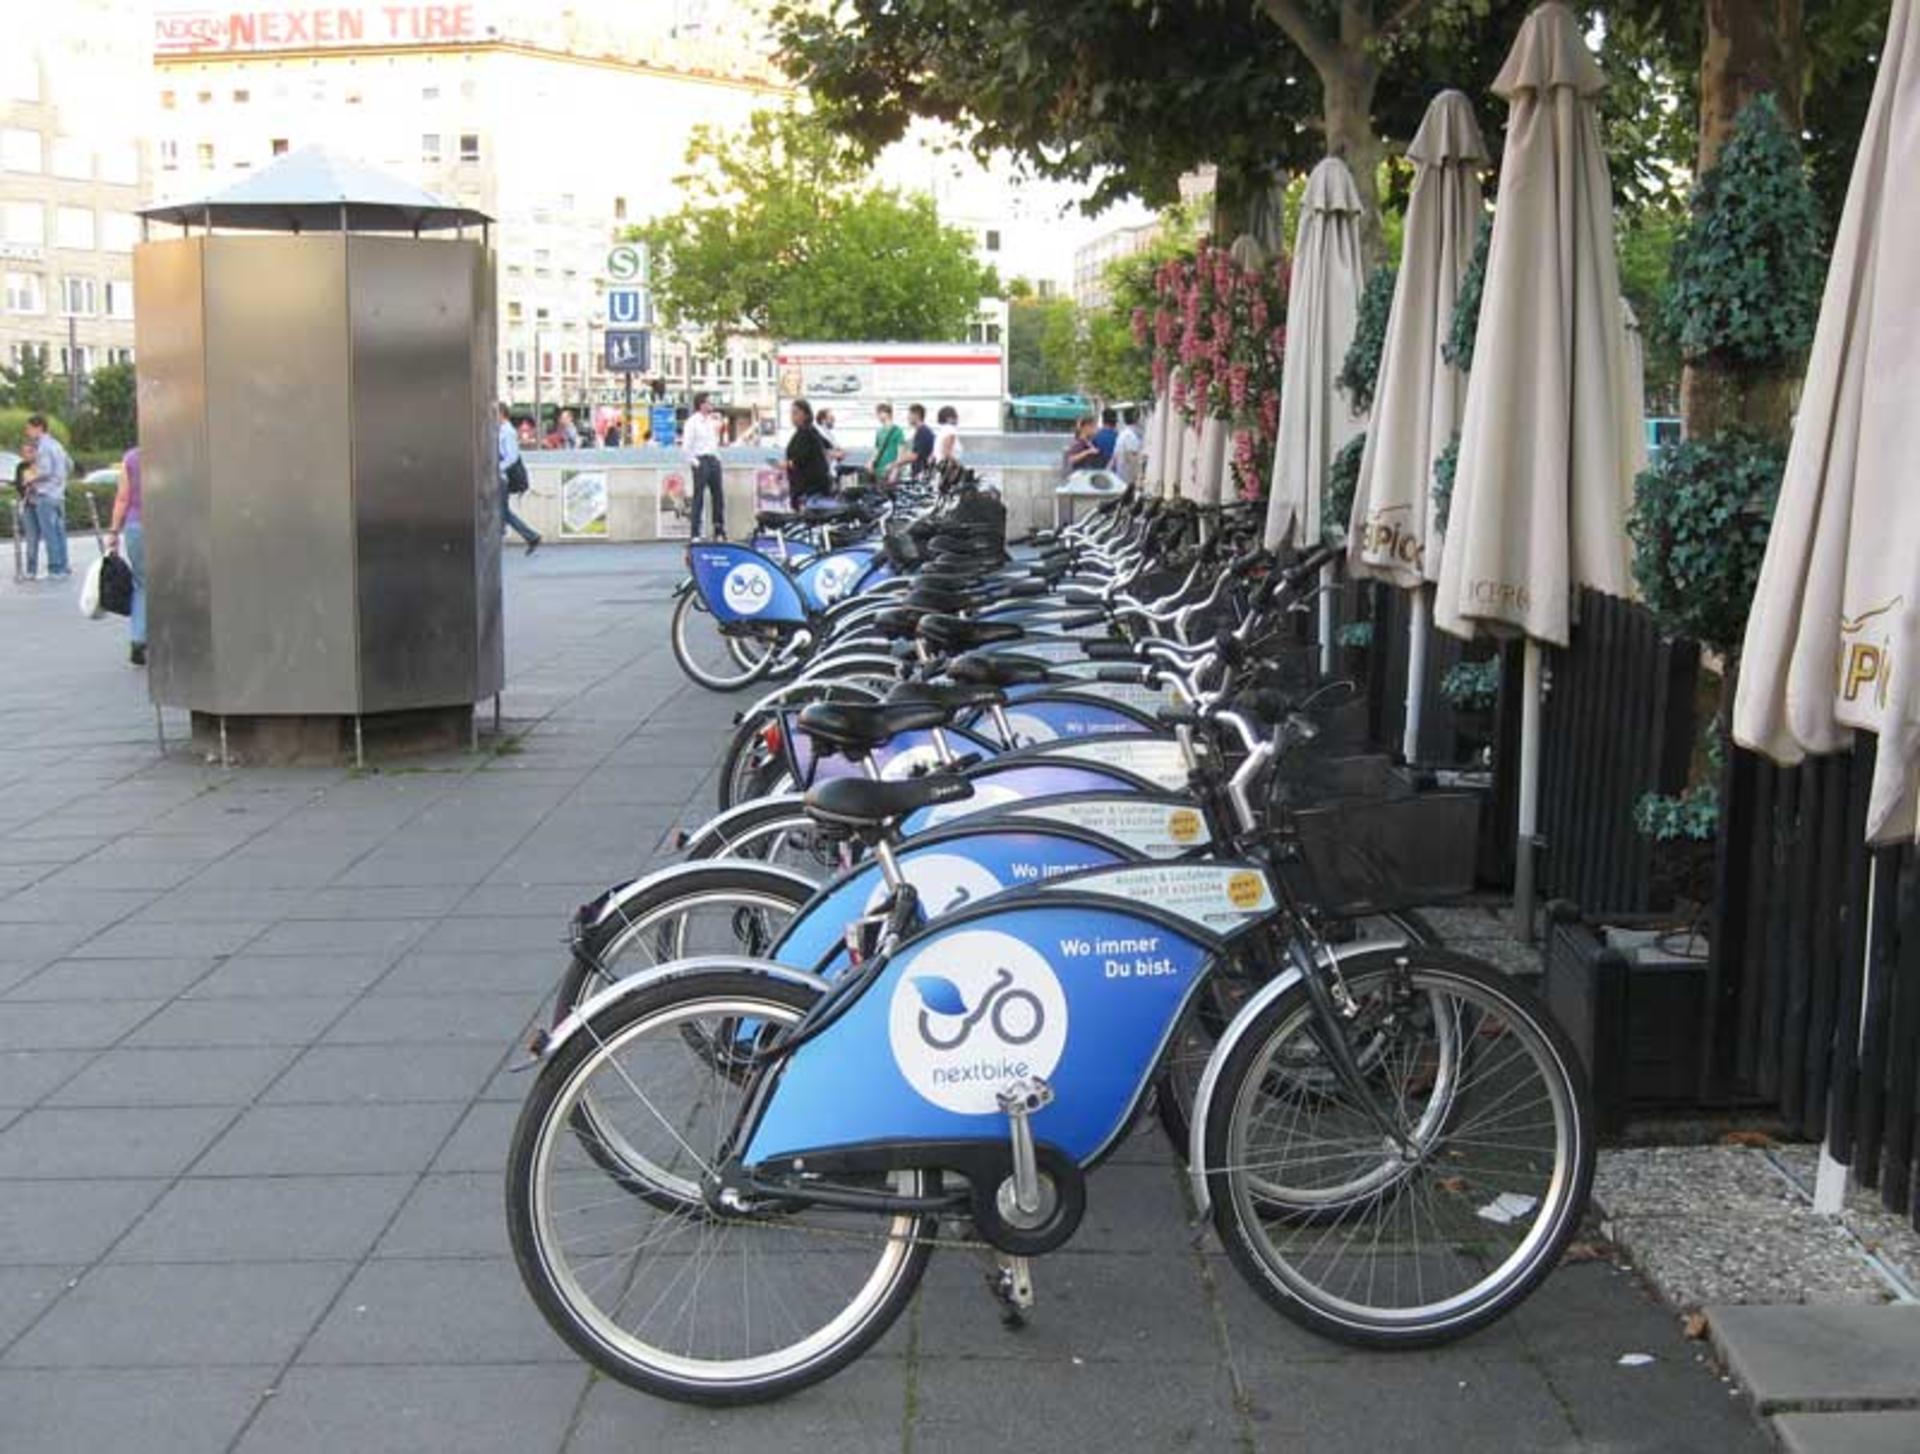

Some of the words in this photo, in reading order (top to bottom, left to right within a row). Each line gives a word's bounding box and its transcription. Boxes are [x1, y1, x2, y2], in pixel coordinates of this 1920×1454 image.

[229, 8, 363, 45] NEXEN
[382, 4, 474, 39] TIRE
[608, 247, 639, 280] S
[612, 292, 636, 322] U
[1011, 862, 1038, 879] Wo
[1042, 861, 1098, 877] imm
[1060, 939, 1091, 957] Wo
[1095, 937, 1160, 955] immer
[1105, 959, 1130, 978] Du
[1136, 958, 1177, 976] bist.
[932, 1057, 1030, 1086] nextbike
